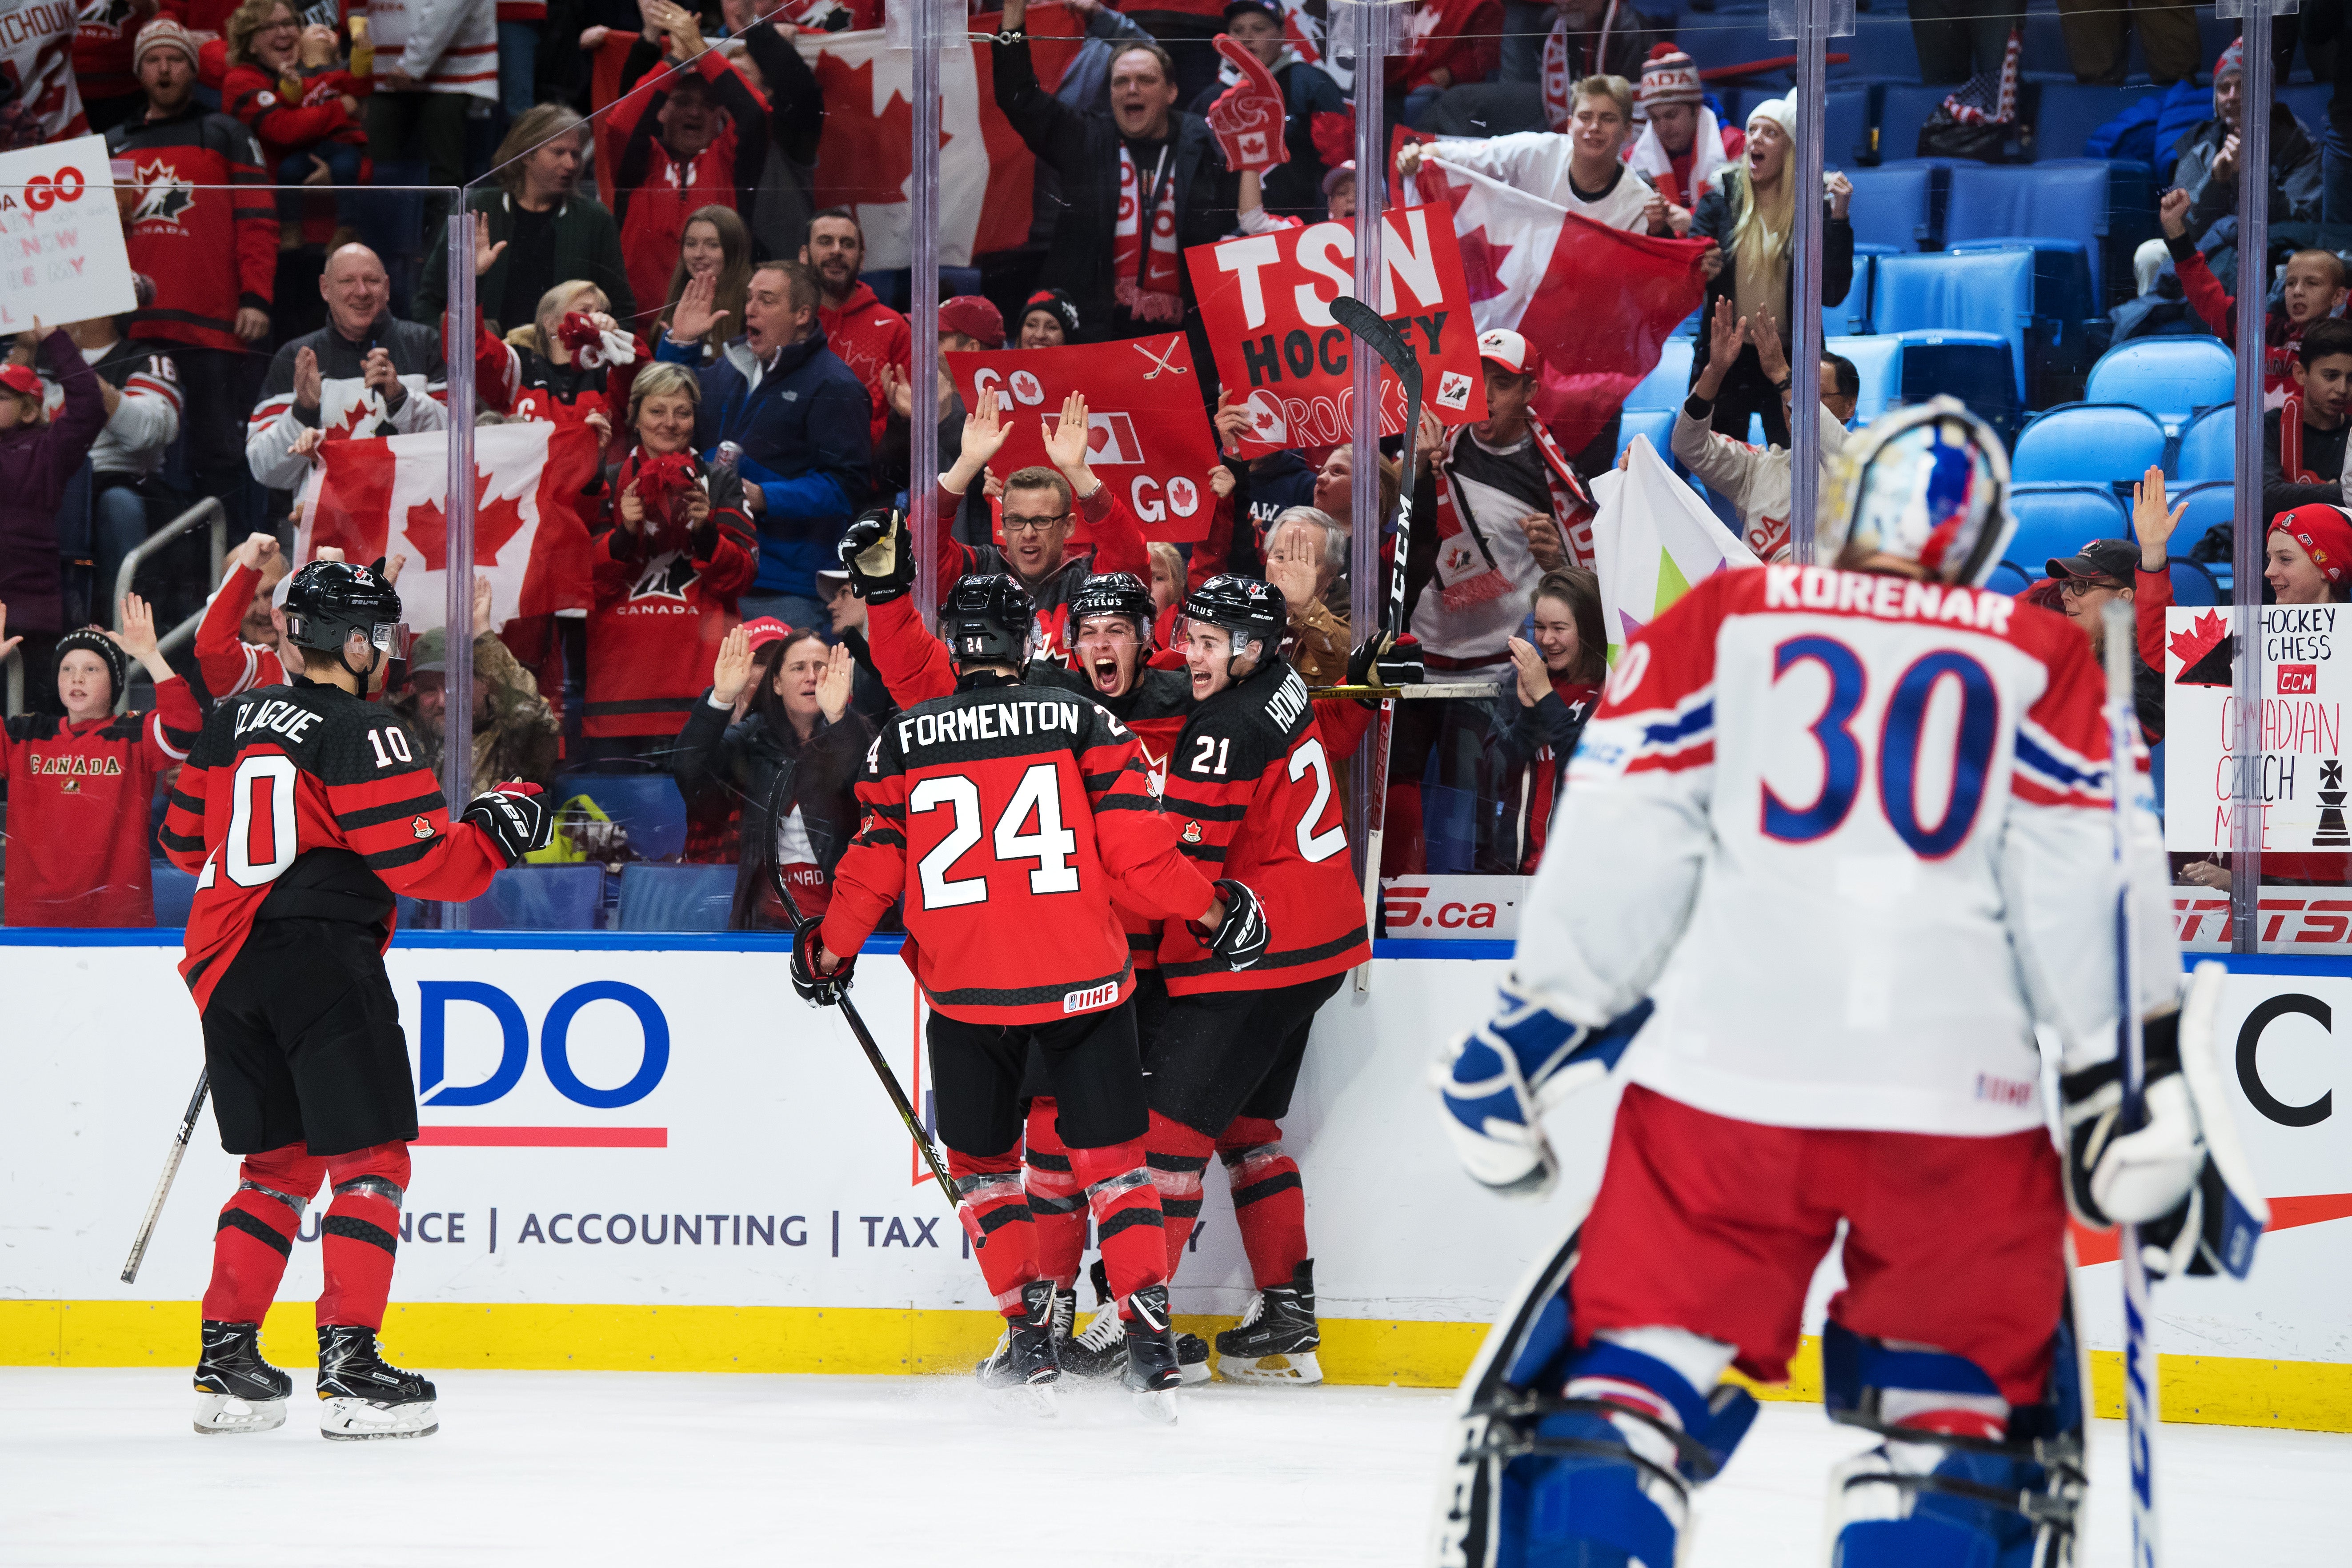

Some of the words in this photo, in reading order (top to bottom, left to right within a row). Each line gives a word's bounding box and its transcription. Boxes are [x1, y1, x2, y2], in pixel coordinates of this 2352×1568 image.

[24, 166, 84, 212] GO
[1214, 209, 1443, 330] TSN
[974, 367, 1046, 411] GO
[1130, 475, 1201, 524] GO
[1391, 493, 1412, 603] CCM
[616, 605, 700, 616] CANADA
[1087, 598, 1122, 607] TELUS
[1188, 603, 1213, 617] TELUS
[1765, 565, 2015, 634] KORENAR
[292, 618, 299, 634] 10
[2259, 608, 2336, 634] HOCKEY
[967, 637, 982, 652] 24
[2268, 634, 2331, 661] CHESS
[2280, 673, 2312, 691] CCM
[235, 700, 324, 744] CLAGUE
[898, 702, 1079, 754] FORMENTON
[30, 754, 122, 776] CANADA
[368, 726, 412, 769] 10
[1191, 735, 1230, 775] 21
[1760, 634, 1999, 861] 30
[910, 762, 1082, 912] 24
[1079, 985, 1113, 1008] IIHF
[2236, 993, 2332, 1127] C
[928, 1144, 950, 1175] CCM
[518, 1213, 808, 1246] ACCOUNTING
[860, 1216, 940, 1248] TAX
[374, 1373, 397, 1383] BAUER
